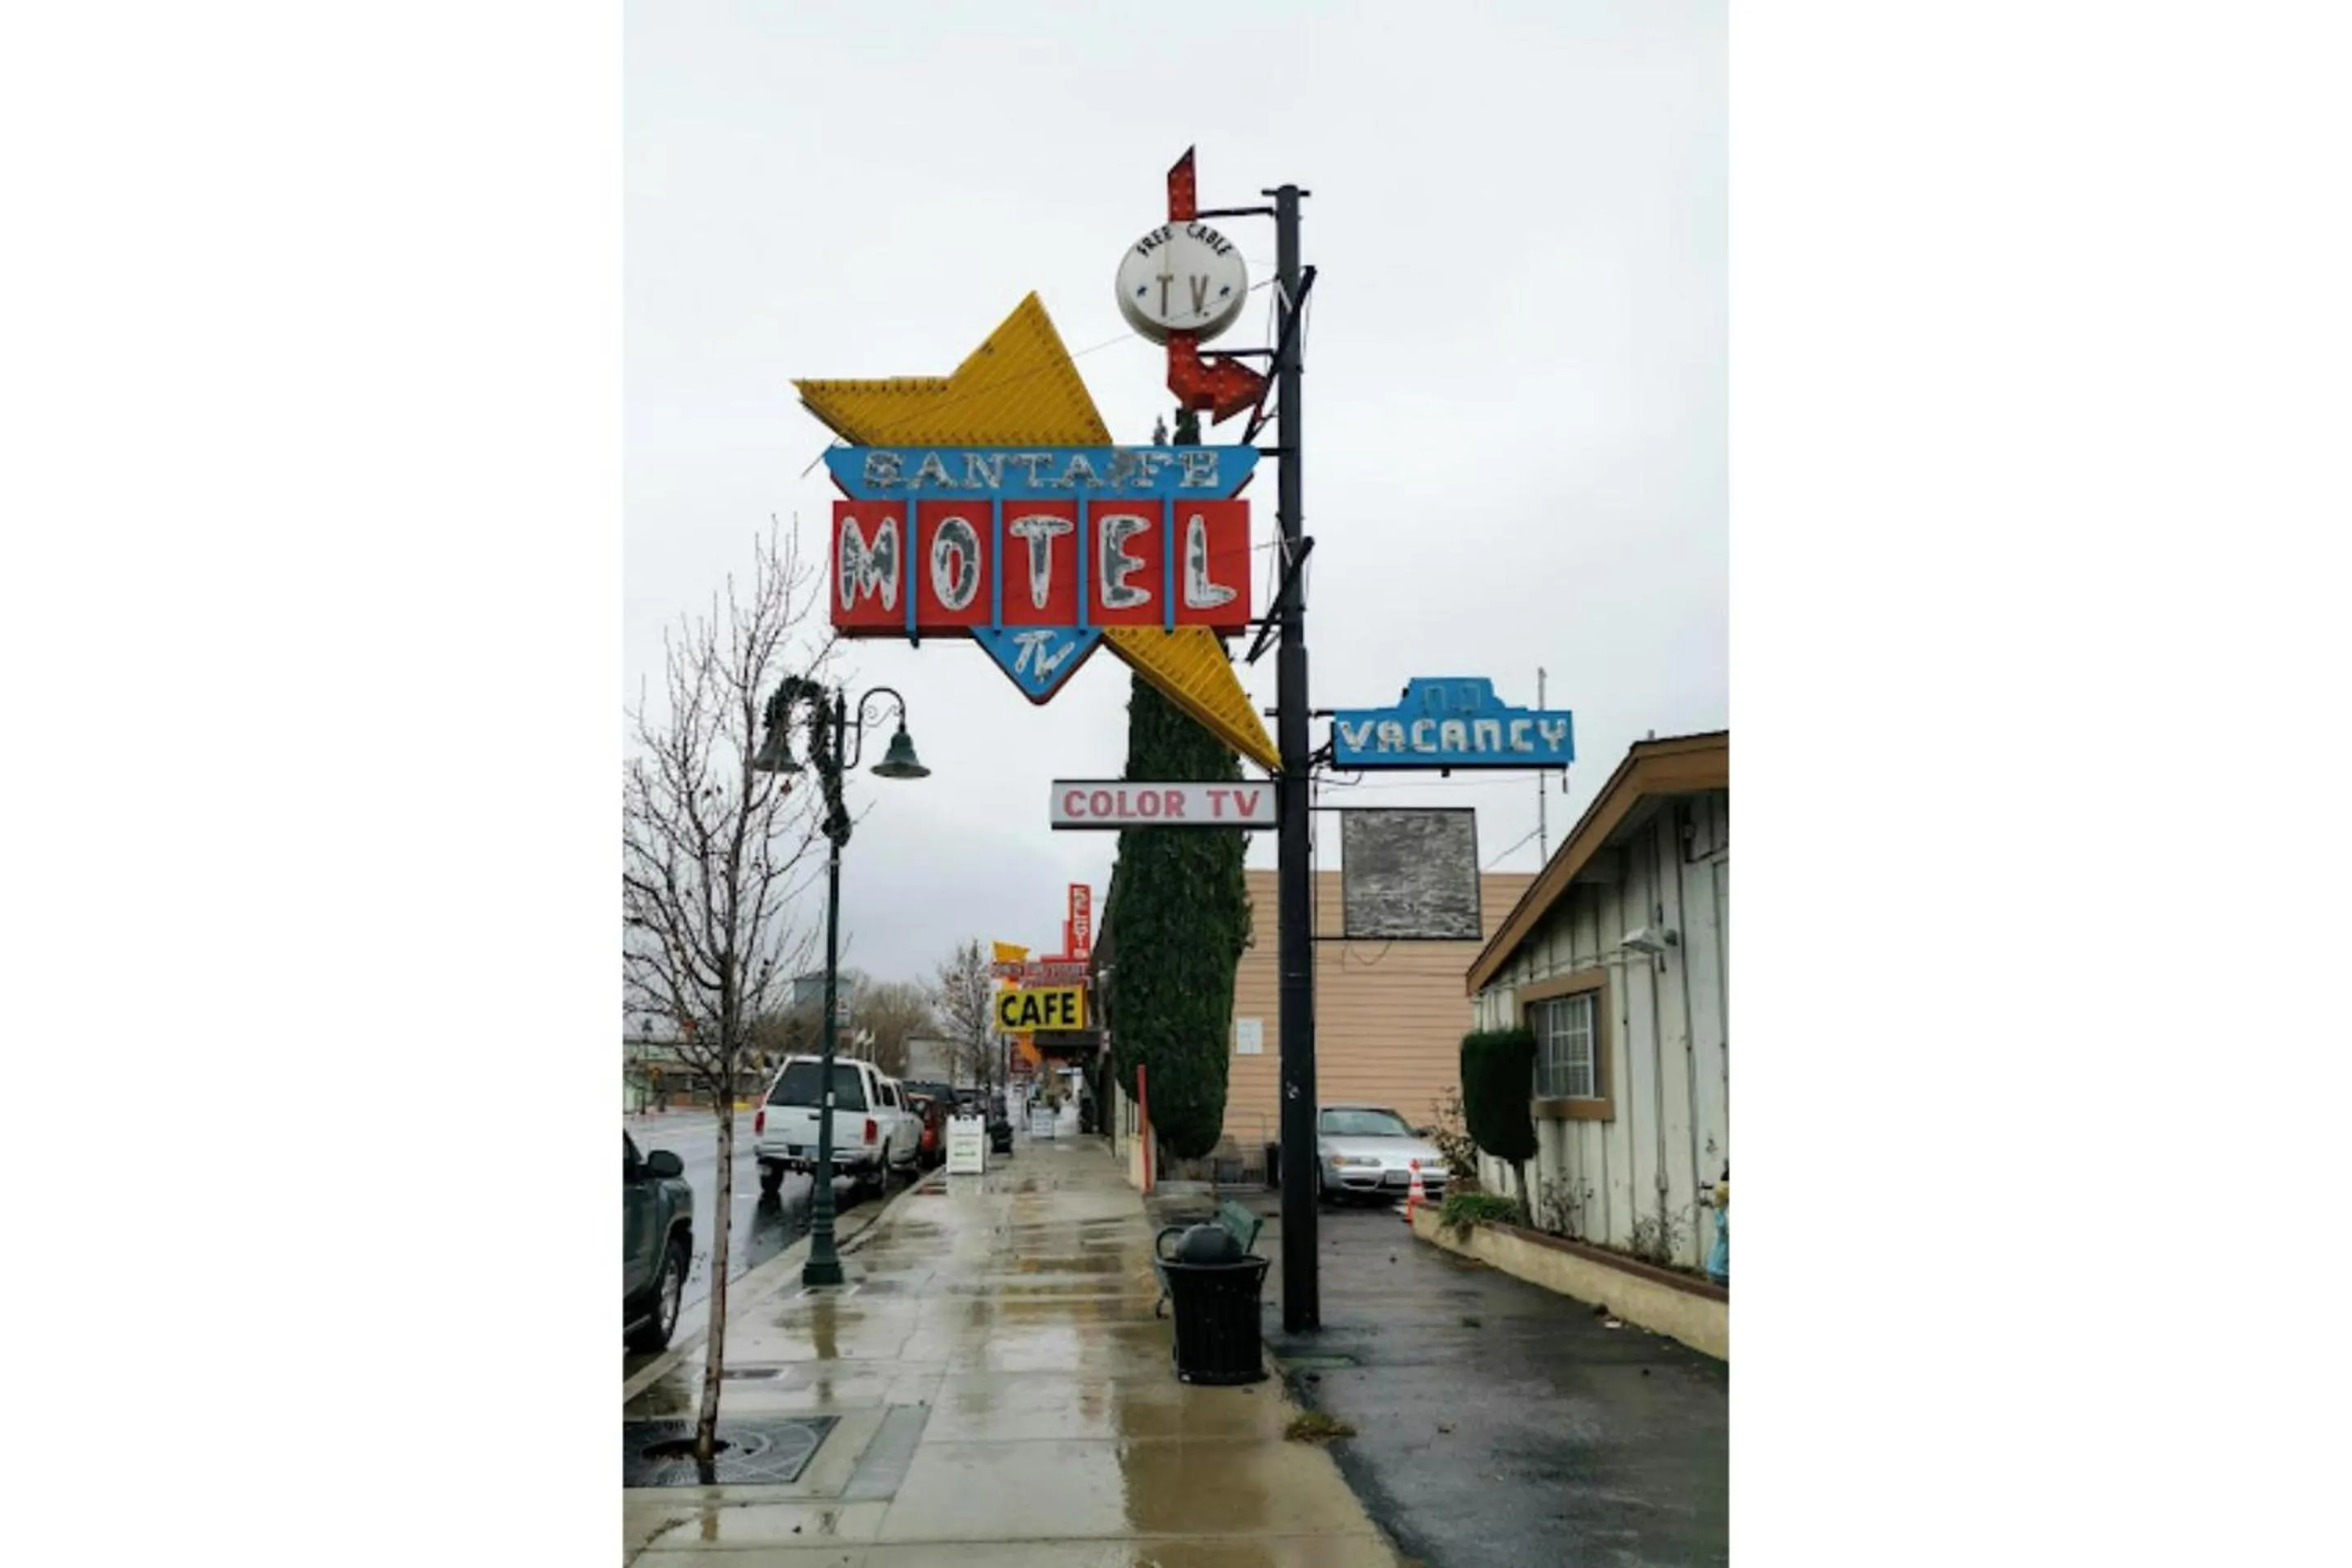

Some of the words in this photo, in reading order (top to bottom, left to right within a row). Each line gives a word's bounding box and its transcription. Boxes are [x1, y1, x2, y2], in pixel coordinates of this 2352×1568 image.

[1136, 225, 1174, 258] FREE
[1186, 223, 1232, 256] CABLE
[863, 451, 1105, 490] SANTA
[1130, 451, 1219, 488] FE
[837, 514, 1237, 612] MOTEL
[1013, 630, 1076, 684] TV
[1336, 717, 1567, 753] VACANCY
[1064, 789, 1187, 818] COLOR
[1205, 789, 1258, 817] TV
[1001, 991, 1076, 1027] CAFE
